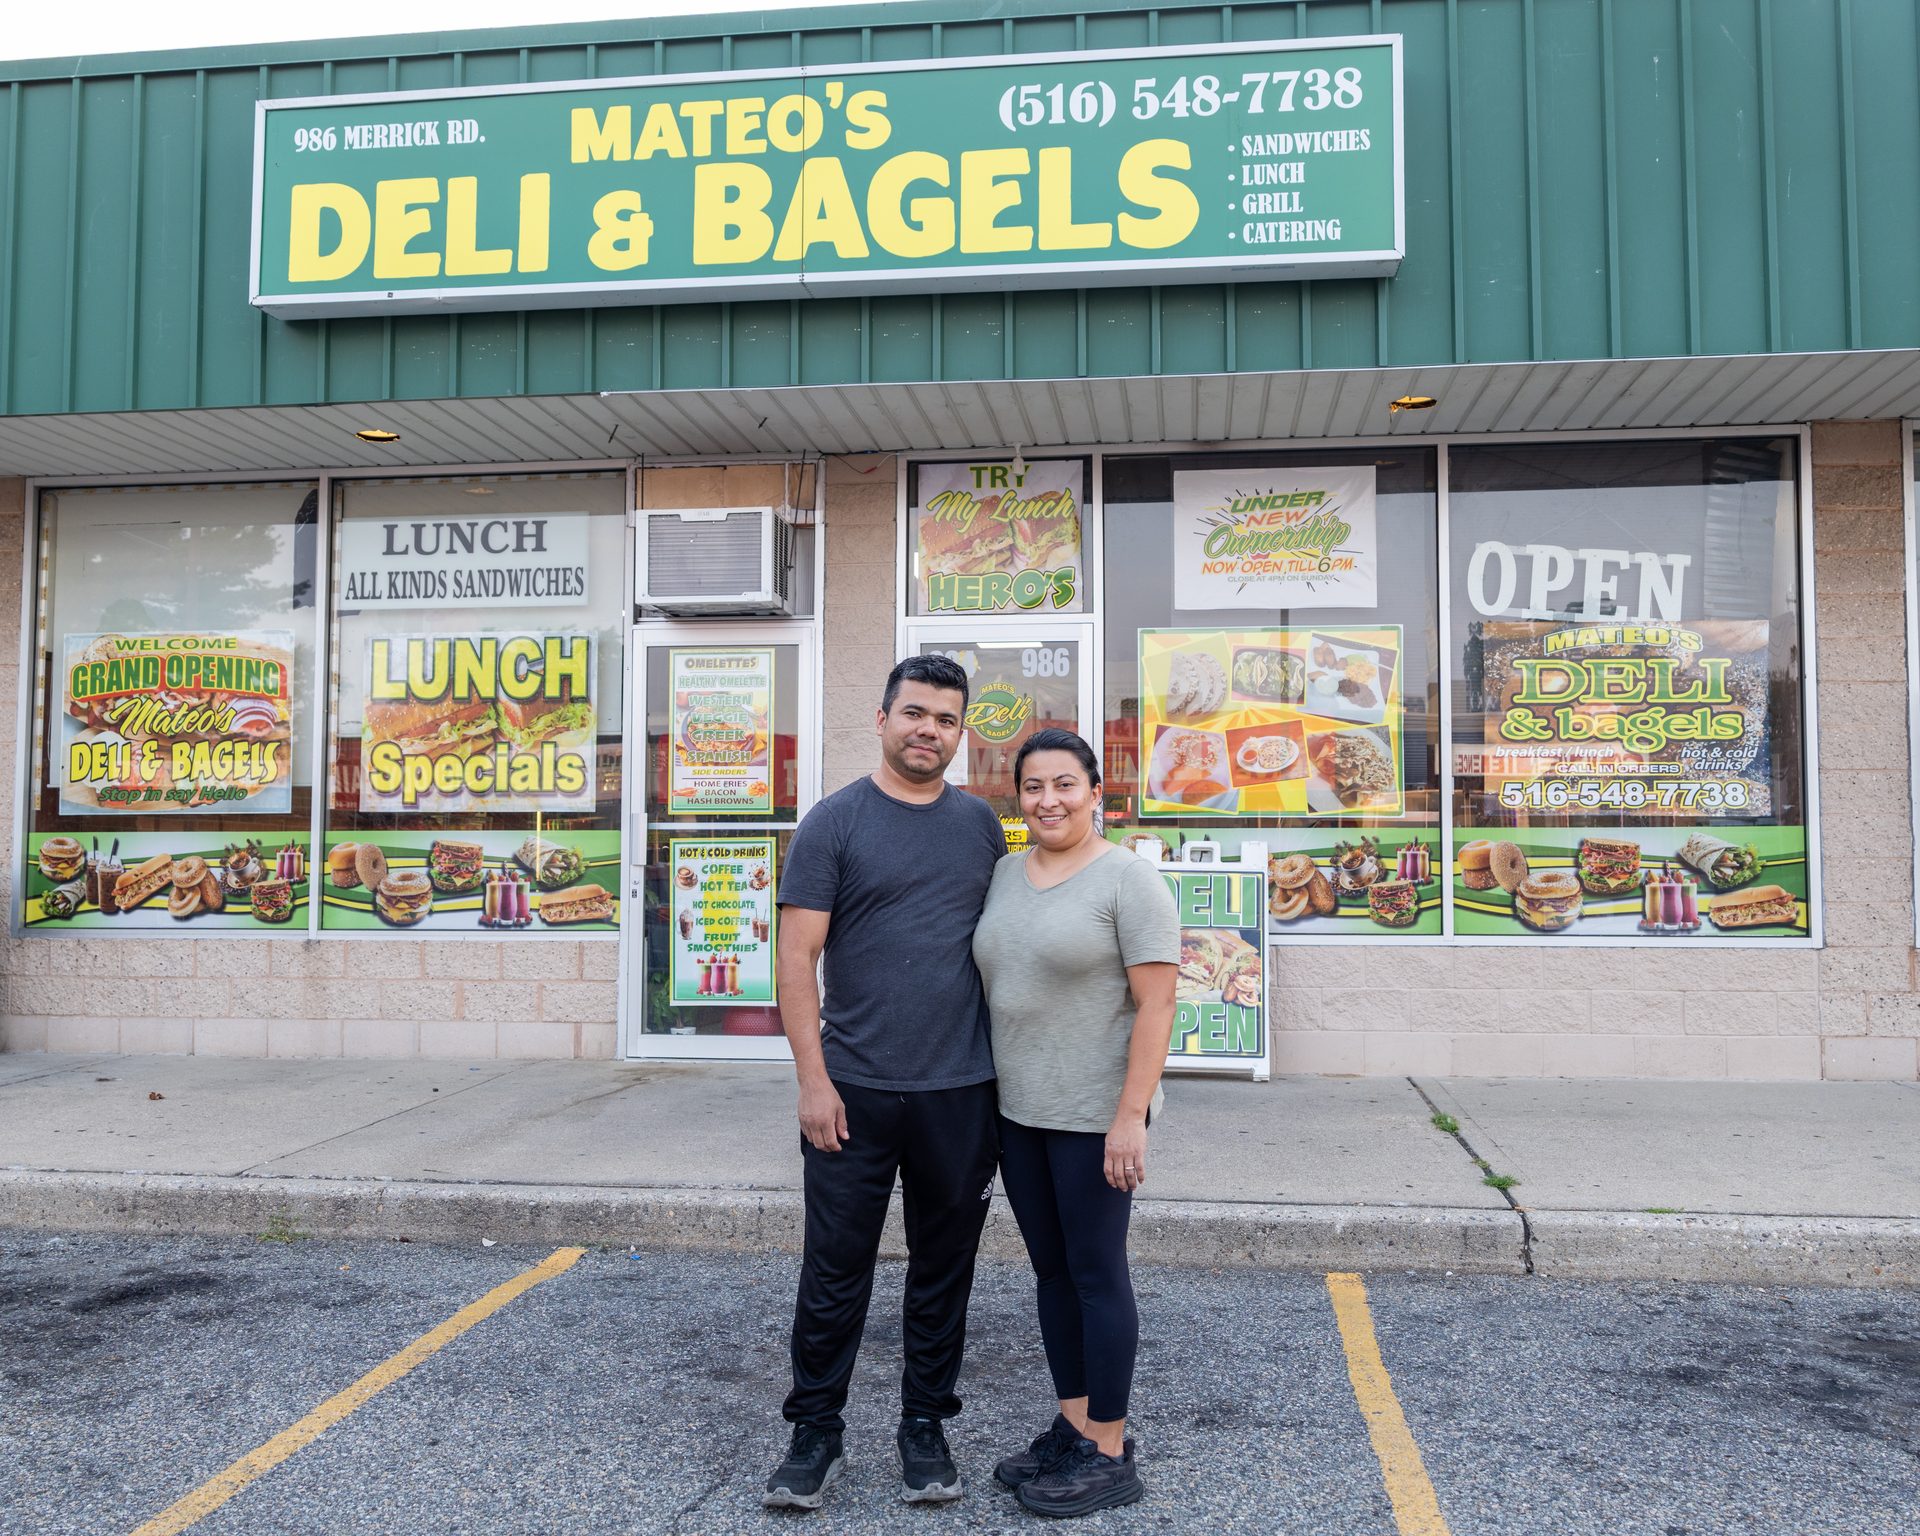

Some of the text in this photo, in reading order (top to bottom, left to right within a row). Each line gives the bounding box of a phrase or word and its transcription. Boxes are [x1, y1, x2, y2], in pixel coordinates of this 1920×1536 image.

[1000, 67, 1364, 132] (516) 548-7738
[294, 118, 486, 153] 986 MERRICK RD.
[571, 82, 891, 164] MATEO'S
[1241, 128, 1371, 157] SANDWICHES
[1241, 161, 1305, 186] LUNCH
[288, 138, 1200, 283] DELI & BAGELS
[1242, 191, 1304, 215] GRILL
[1242, 218, 1342, 244] CATERING
[926, 487, 1075, 534] My Lunch
[1230, 490, 1326, 514] UNDER
[1245, 508, 1309, 528] NEW
[382, 520, 547, 556] LUNCH
[1203, 514, 1352, 559] Ownership
[1202, 560, 1238, 575] NOW
[1241, 559, 1283, 573] OPEN
[1287, 558, 1317, 573] TILL
[1301, 574, 1334, 582] SUNDAY
[345, 566, 584, 600] ALL KINDS SANDWICHES
[928, 566, 1075, 612] HERO'S
[1467, 540, 1691, 622] OPEN
[115, 637, 237, 651] WELCOME
[1545, 625, 1702, 653] MATEO'S
[370, 636, 590, 701] LUNCH
[685, 656, 758, 670] OMELETTES
[1022, 647, 1070, 677] 986
[71, 654, 280, 699] GRAND OPENING
[679, 675, 767, 688] HEALTHY OMELETTE
[981, 683, 1015, 694] MATEO'S
[1512, 657, 1731, 704] DELI
[688, 693, 753, 706] WESTERN
[964, 696, 1032, 727] Deli
[111, 698, 236, 736] Mateo's
[691, 712, 748, 723] VEGGIE
[691, 728, 747, 742] GREEK
[1500, 707, 1743, 754] & bagels
[70, 740, 281, 783] DELI & BAGELS
[687, 750, 752, 763] SPANISH
[1496, 746, 1560, 758] breakfast
[1575, 746, 1614, 758] lunch
[1681, 747, 1758, 758] hot & cold
[369, 740, 586, 805] Specials
[1557, 764, 1681, 774] CALL IN ORDERS
[98, 784, 248, 805] Stop in say Hello
[1501, 780, 1748, 808] 516-548-7738
[680, 848, 699, 857] HOT
[708, 848, 731, 857] COLD
[734, 846, 767, 857] DRINKS
[702, 864, 743, 874] COFFEE
[700, 881, 748, 891] HOT TEA
[693, 901, 755, 909] HOT CHOCOLATE
[696, 917, 750, 926] ICED COFFEE
[704, 934, 741, 942] FRUIT
[1168, 999, 1258, 1053] PEN
